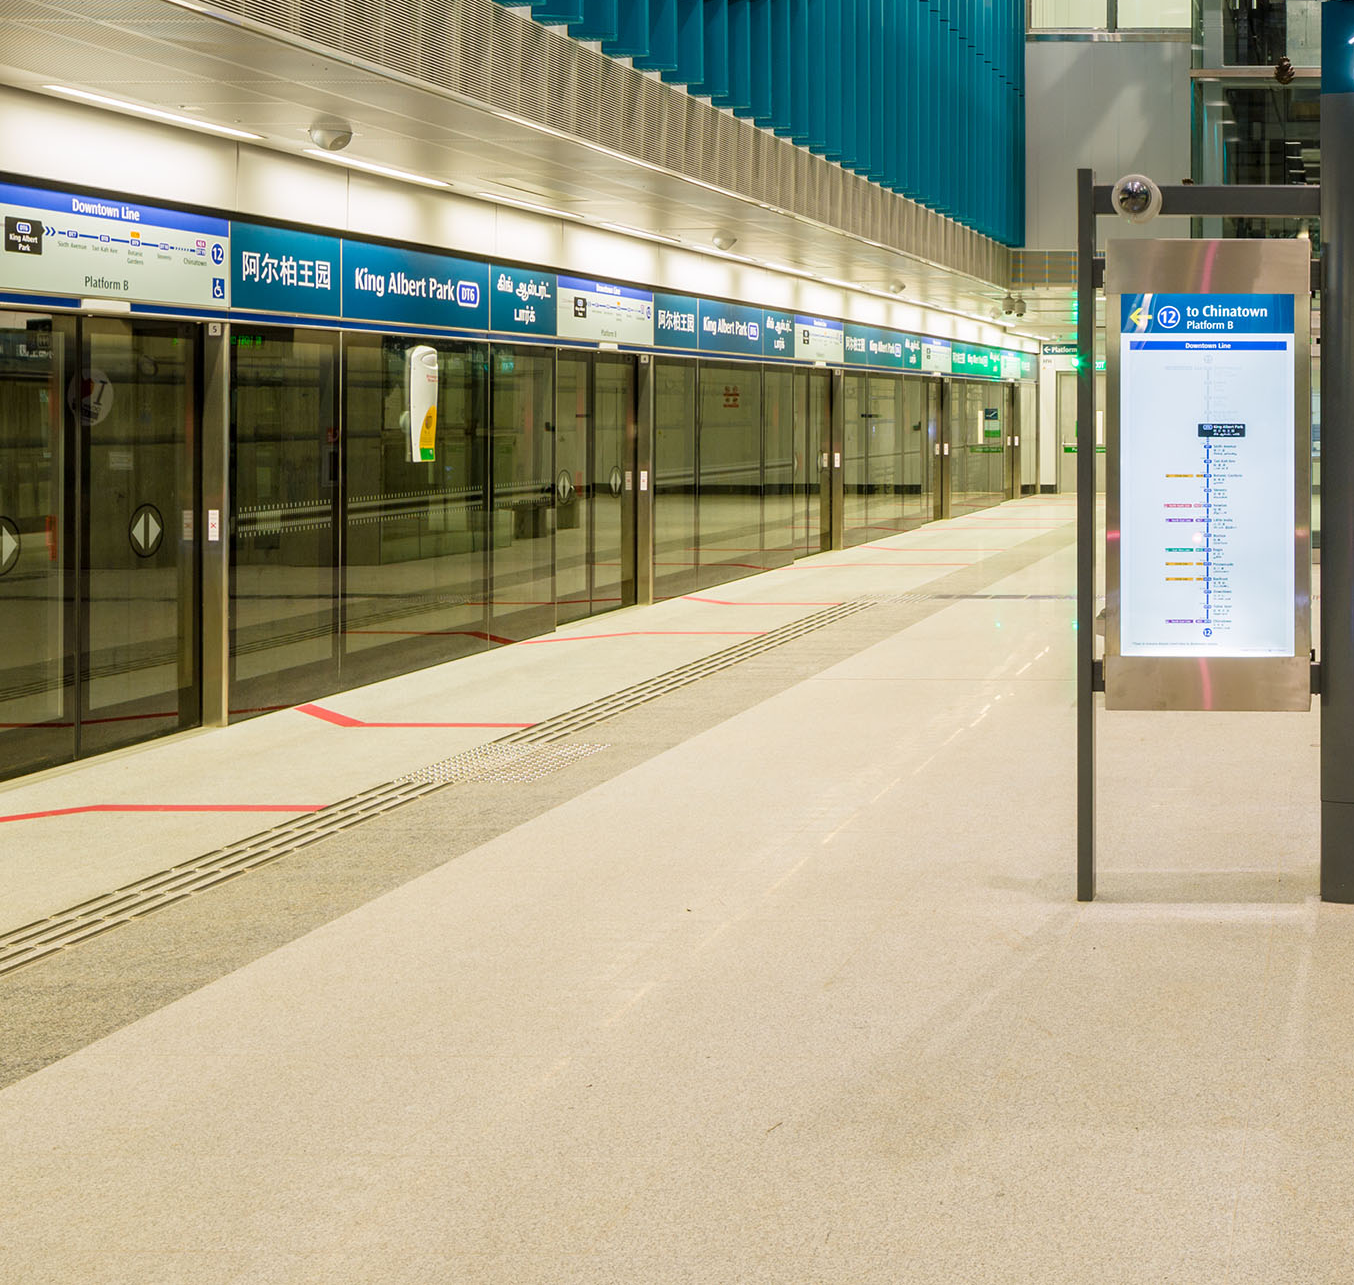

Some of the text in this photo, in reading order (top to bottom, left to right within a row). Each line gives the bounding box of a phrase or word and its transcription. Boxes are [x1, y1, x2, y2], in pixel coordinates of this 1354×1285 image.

[72, 198, 140, 221] Downtown Line
[9, 233, 38, 244] King Albert
[18, 243, 31, 252] Park
[213, 247, 223, 261] 12
[183, 257, 208, 268] Chinatown
[242, 250, 331, 290] 阿尔柏王园
[84, 276, 129, 291] Platform B
[354, 267, 476, 302] King Albert Park DT6
[497, 273, 551, 302] கிங் ஆல்பர்ட்
[514, 305, 536, 326] பார்க்
[1160, 304, 1268, 324] 12 to Chinatown
[212, 325, 218, 334] 5
[703, 316, 717, 336] King
[717, 317, 735, 335] Albert
[734, 320, 748, 336] Park
[1186, 320, 1234, 330] Platform B
[1051, 346, 1078, 354] Platform
